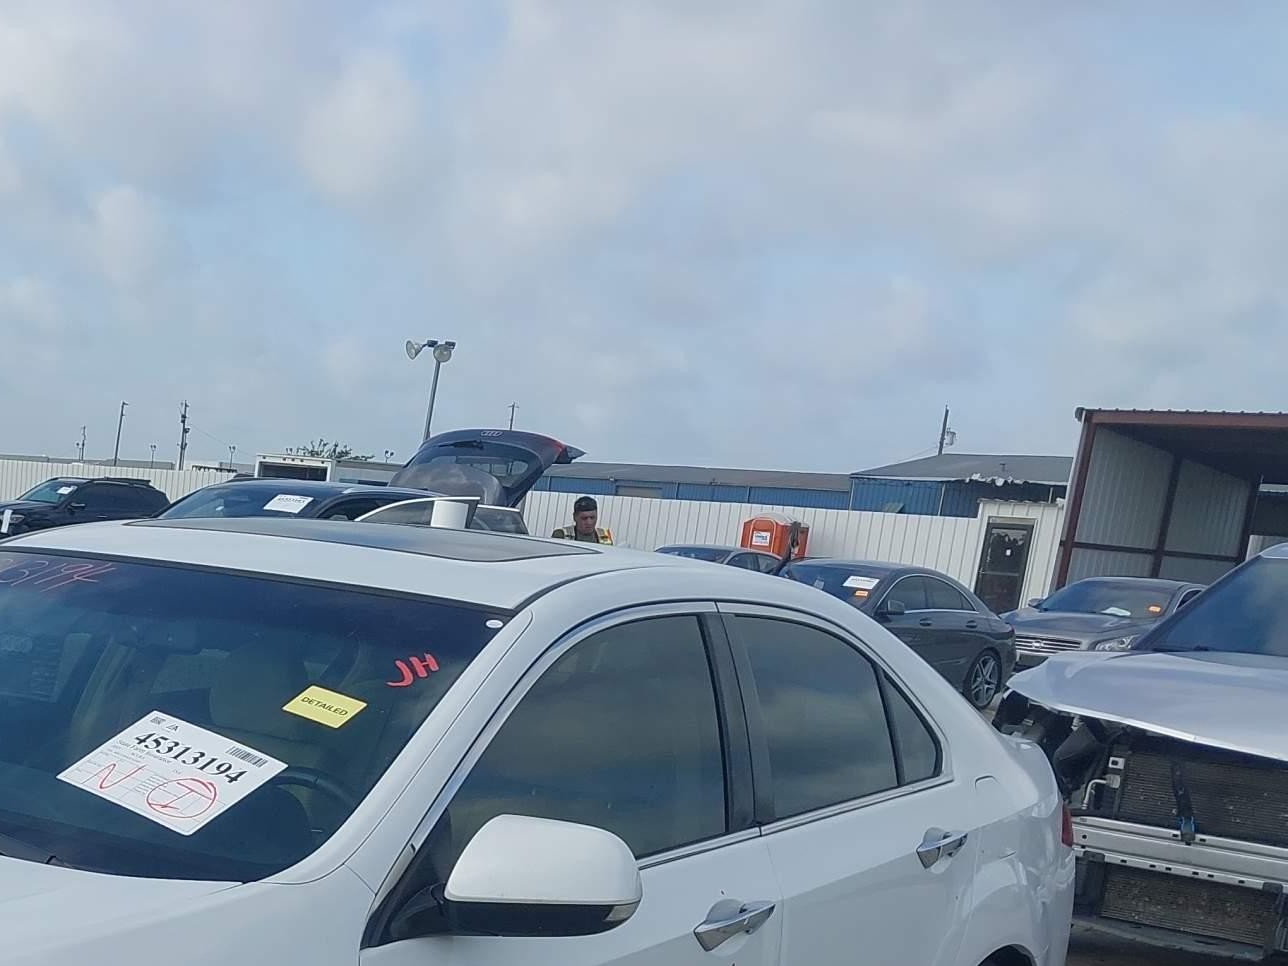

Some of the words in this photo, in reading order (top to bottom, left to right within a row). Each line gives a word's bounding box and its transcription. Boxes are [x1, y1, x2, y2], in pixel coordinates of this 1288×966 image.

[386, 653, 439, 687] JH
[301, 696, 349, 716] DETAILED
[135, 733, 248, 784] 45313194
[80, 763, 147, 790] N
